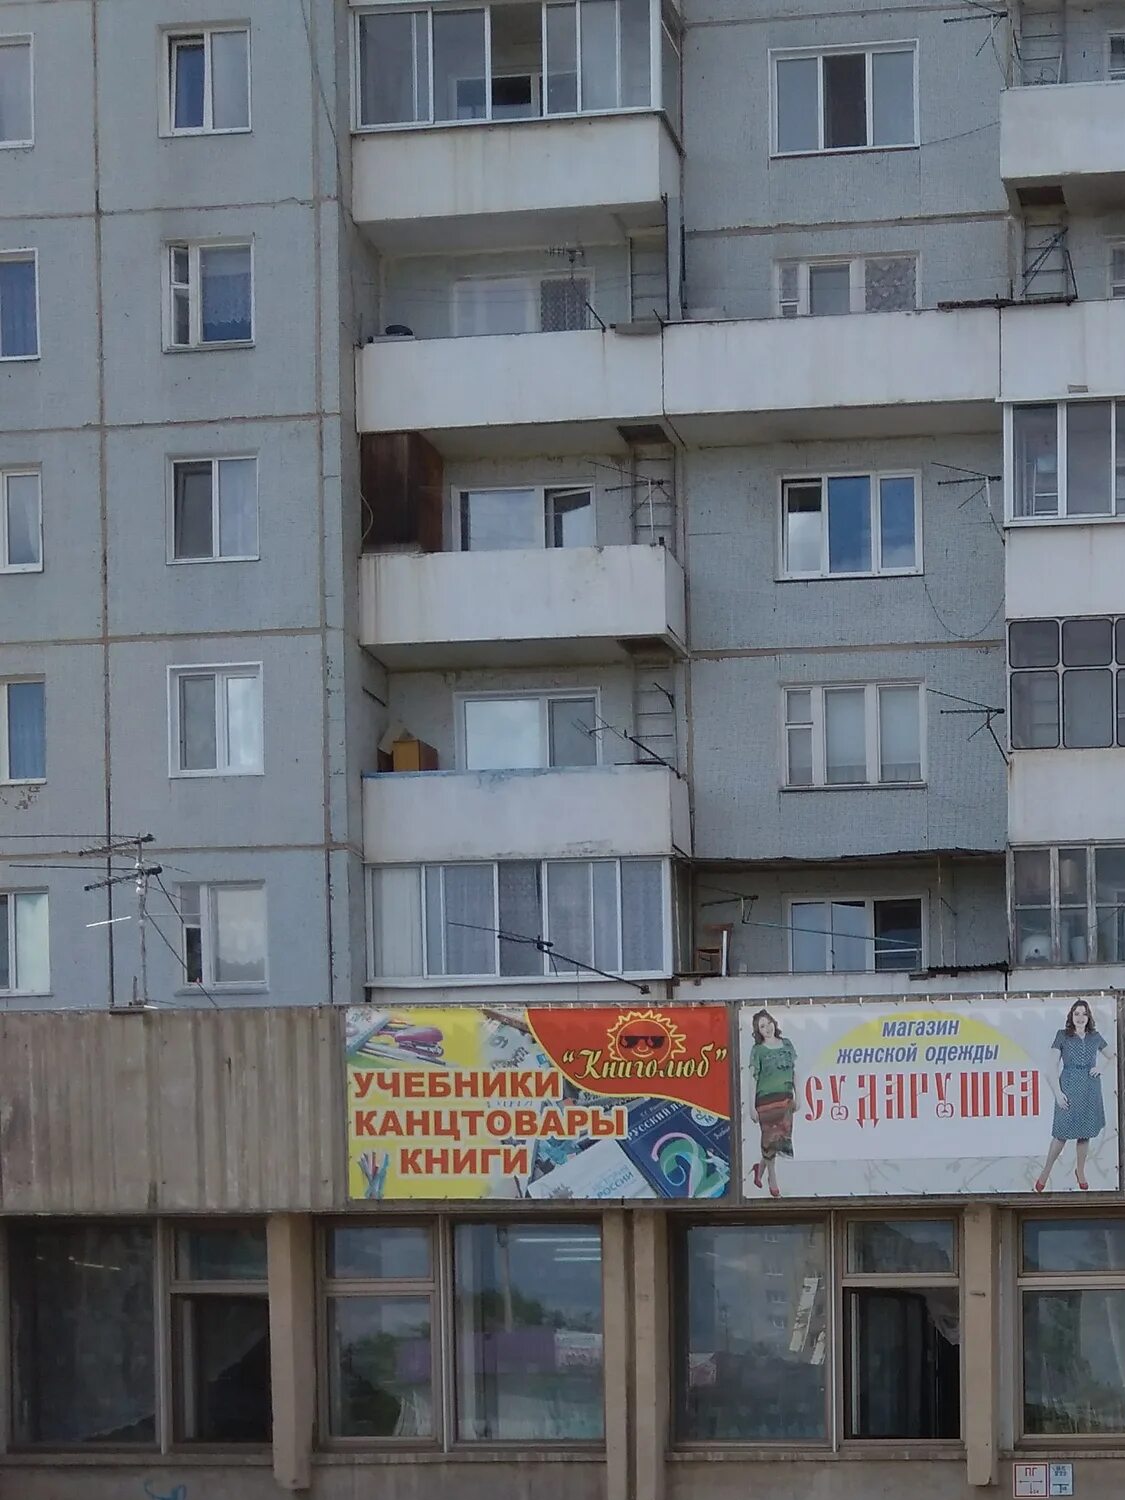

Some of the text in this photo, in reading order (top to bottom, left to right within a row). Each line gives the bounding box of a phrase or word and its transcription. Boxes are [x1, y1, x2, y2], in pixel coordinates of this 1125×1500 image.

[882, 1018, 960, 1038] магазин
[836, 1042, 999, 1066] женской одежды
[353, 1071, 561, 1099] УЧЕБНИКИ
[804, 1070, 1041, 1129] СУДАРУШКА
[354, 1109, 625, 1141] КАНЦТОВАРЫ
[400, 1147, 528, 1175] КНИГИ
[1024, 1467, 1038, 1477] ПГ
